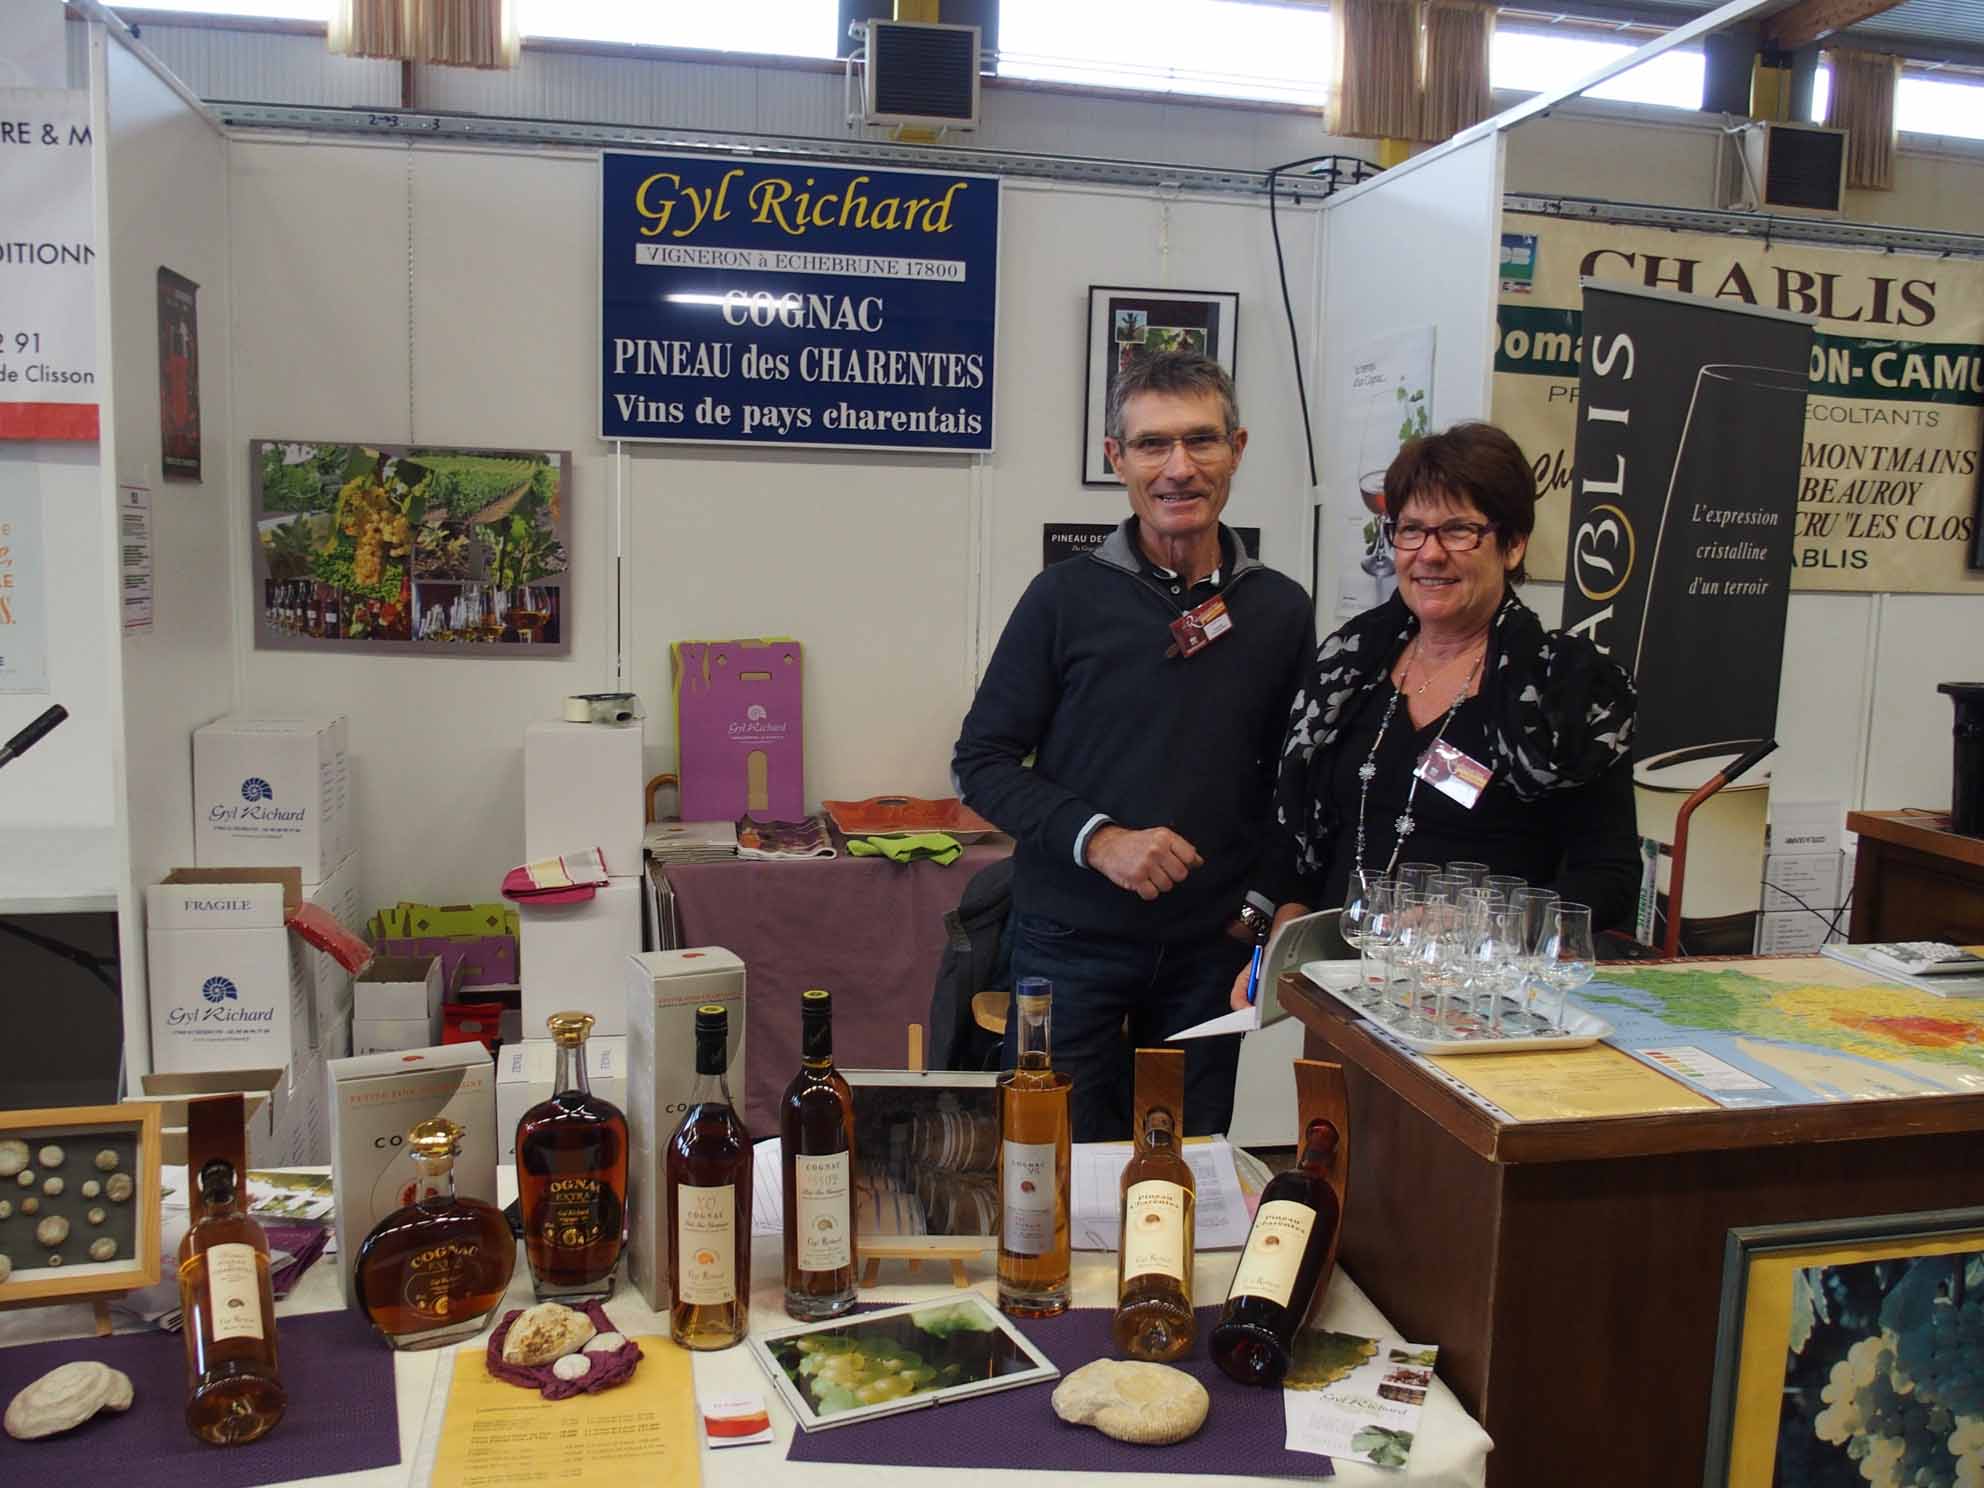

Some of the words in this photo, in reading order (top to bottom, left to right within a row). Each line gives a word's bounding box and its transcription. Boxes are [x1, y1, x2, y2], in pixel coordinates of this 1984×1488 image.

[42, 123, 59, 145] &
[634, 168, 745, 237] Gyl
[748, 176, 968, 235] Richard
[647, 246, 752, 268] VIGNERON
[758, 255, 768, 268] à
[775, 255, 899, 276] ECHEBRUNE
[905, 260, 958, 279] 17800
[721, 289, 884, 332] COGNAC
[15, 333, 41, 353] 91
[25, 364, 94, 384] Clisson
[613, 338, 733, 379] PINEAU
[742, 343, 790, 380] des
[799, 346, 983, 389] CHARENTES
[614, 393, 684, 423] Vins
[695, 396, 731, 425] de
[743, 405, 812, 435] pays
[823, 402, 983, 434] charentais
[1800, 442, 1978, 475] MONTMAINS
[1799, 476, 1924, 506] BEAUROY
[1691, 503, 1779, 528] L'expression
[1051, 533, 1087, 543] PINEAU
[1696, 540, 1768, 562] cristalline
[1689, 575, 1720, 596] d'un
[1724, 578, 1769, 596] terroir
[208, 804, 237, 823] Gyl
[240, 805, 305, 822] Richard
[184, 899, 251, 912] FRAGILE
[167, 1007, 199, 1026] Gyl
[202, 1006, 274, 1022] Richard
